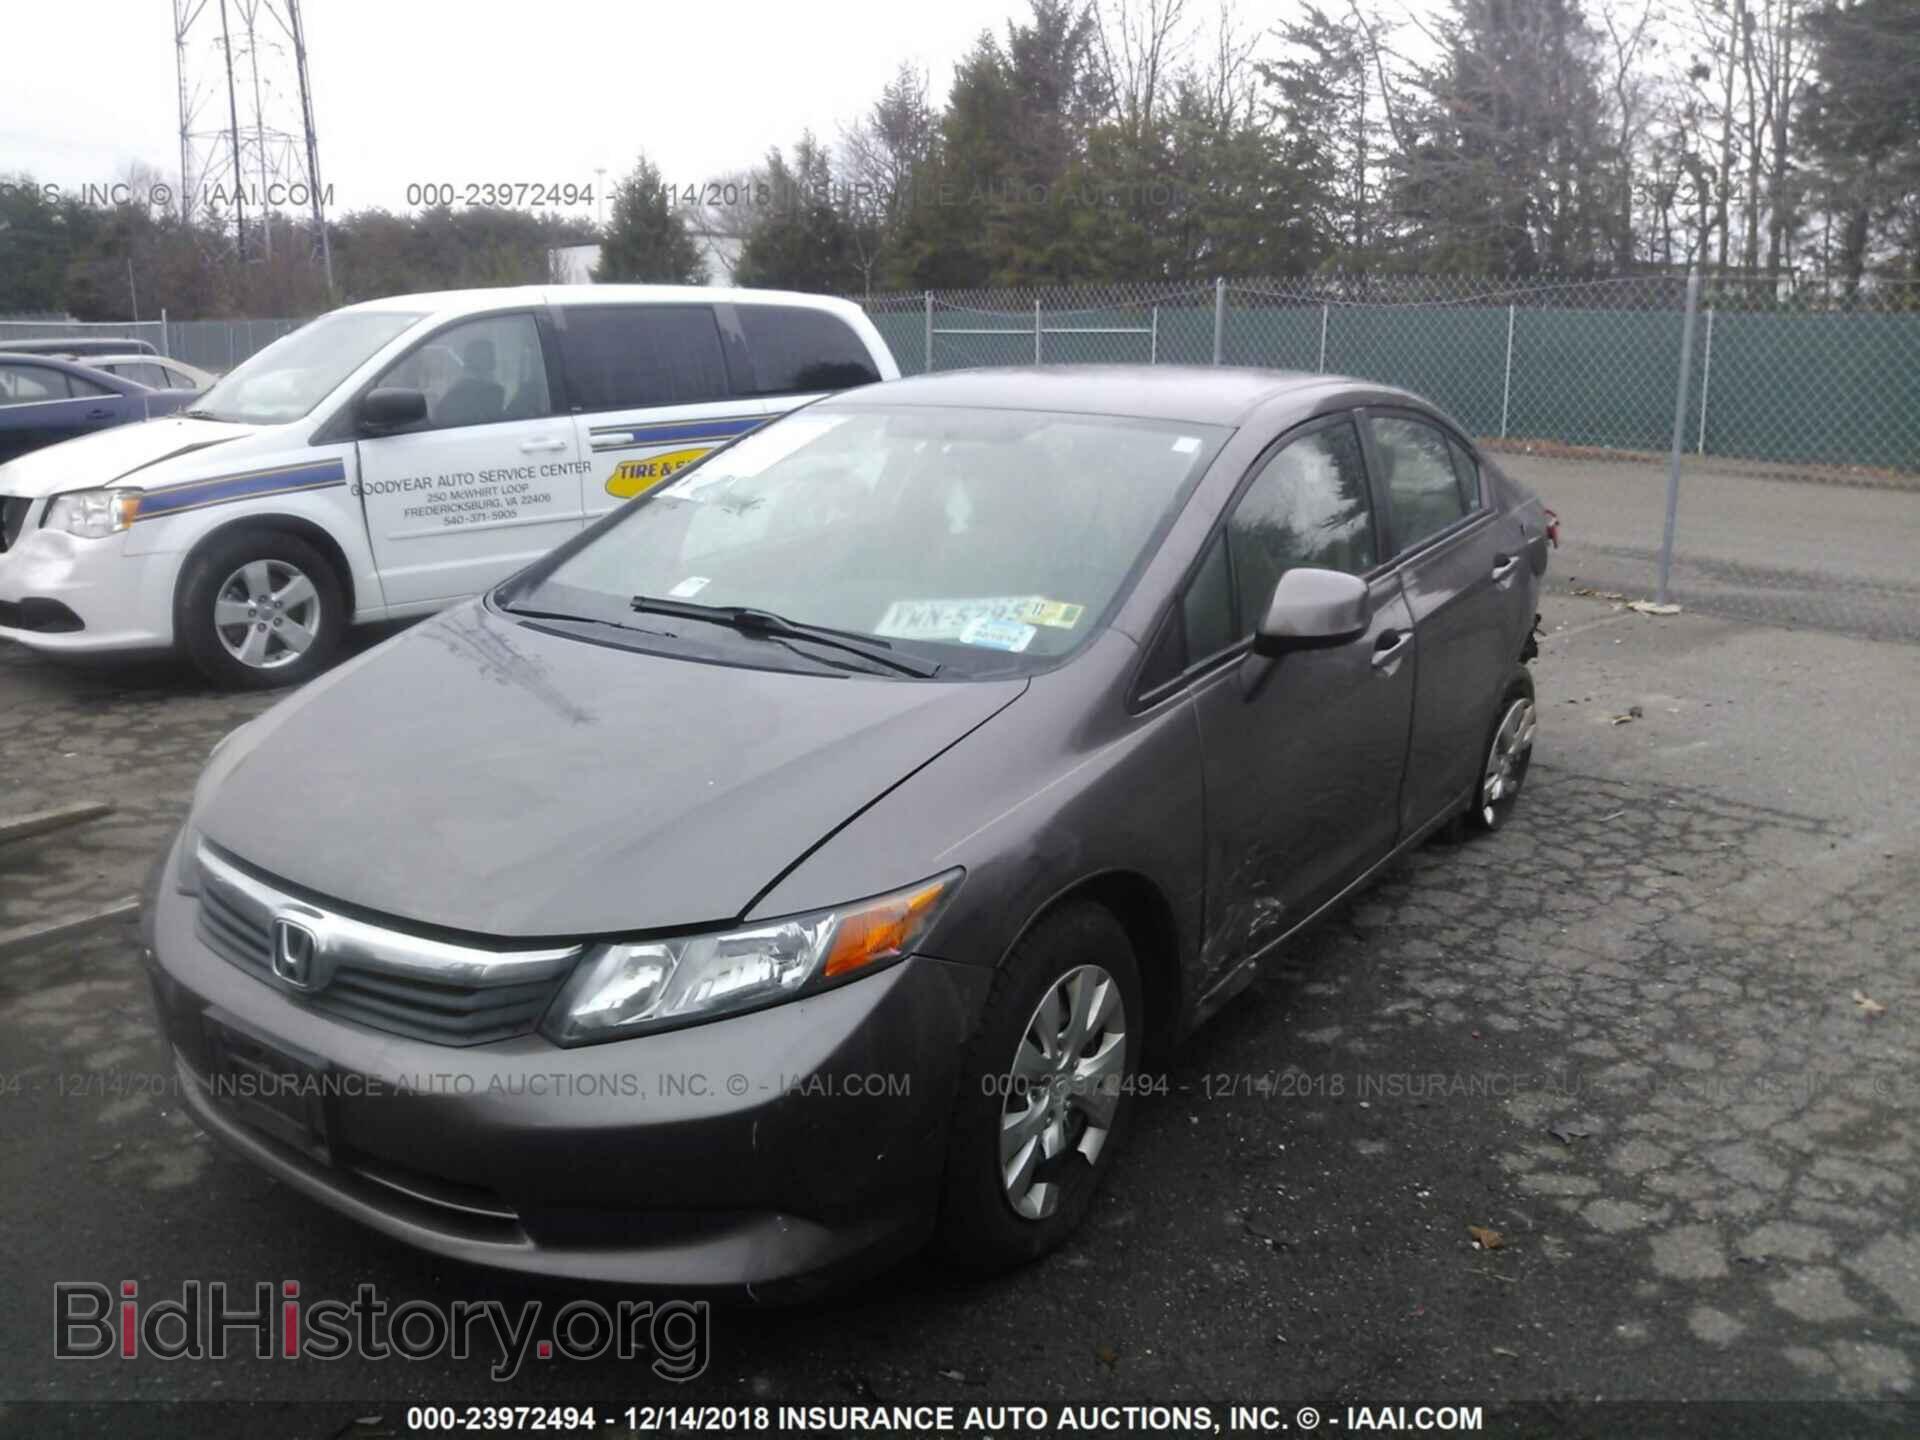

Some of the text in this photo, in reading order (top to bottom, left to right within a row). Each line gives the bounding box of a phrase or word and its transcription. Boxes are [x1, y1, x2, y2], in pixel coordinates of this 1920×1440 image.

[351, 461, 592, 496] GOODYEAR AUTO SERVICE CENTER
[620, 463, 658, 479] TIRE
[660, 462, 672, 476] &
[427, 492, 447, 503] 250
[501, 483, 529, 496] LOOP
[404, 499, 502, 518] FREDERICKSBURG,
[504, 497, 519, 508] VA
